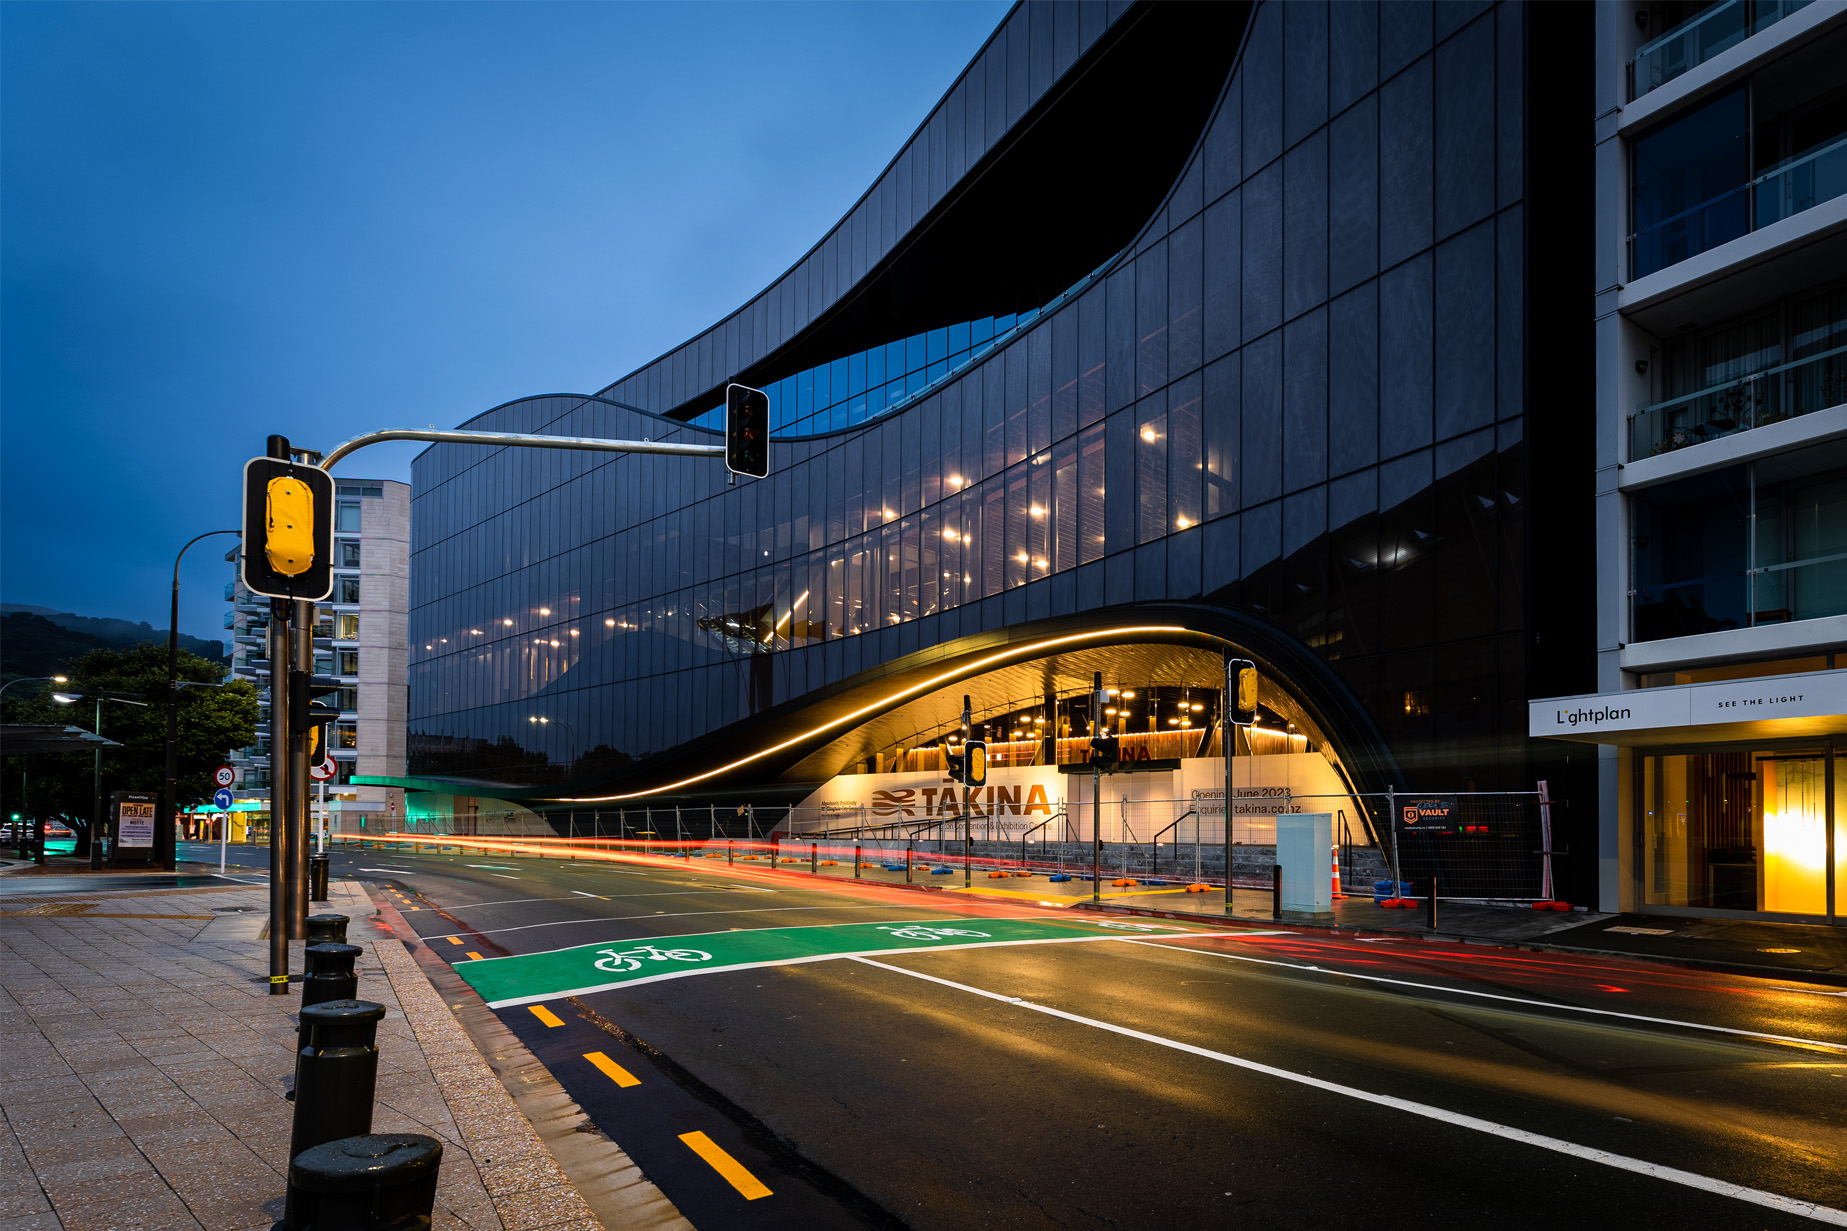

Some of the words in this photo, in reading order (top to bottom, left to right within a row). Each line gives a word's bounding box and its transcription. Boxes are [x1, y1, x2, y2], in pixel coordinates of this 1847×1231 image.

[1769, 695, 1804, 704] LIGHT
[1080, 746, 1152, 763] TNA
[219, 772, 231, 780] 50
[1191, 790, 1229, 800] Openin
[1233, 789, 1259, 799] June
[1262, 787, 1291, 798] 2023
[122, 806, 138, 815] OPEN
[139, 807, 153, 816] LATE
[1235, 803, 1301, 814] takina.co.nz
